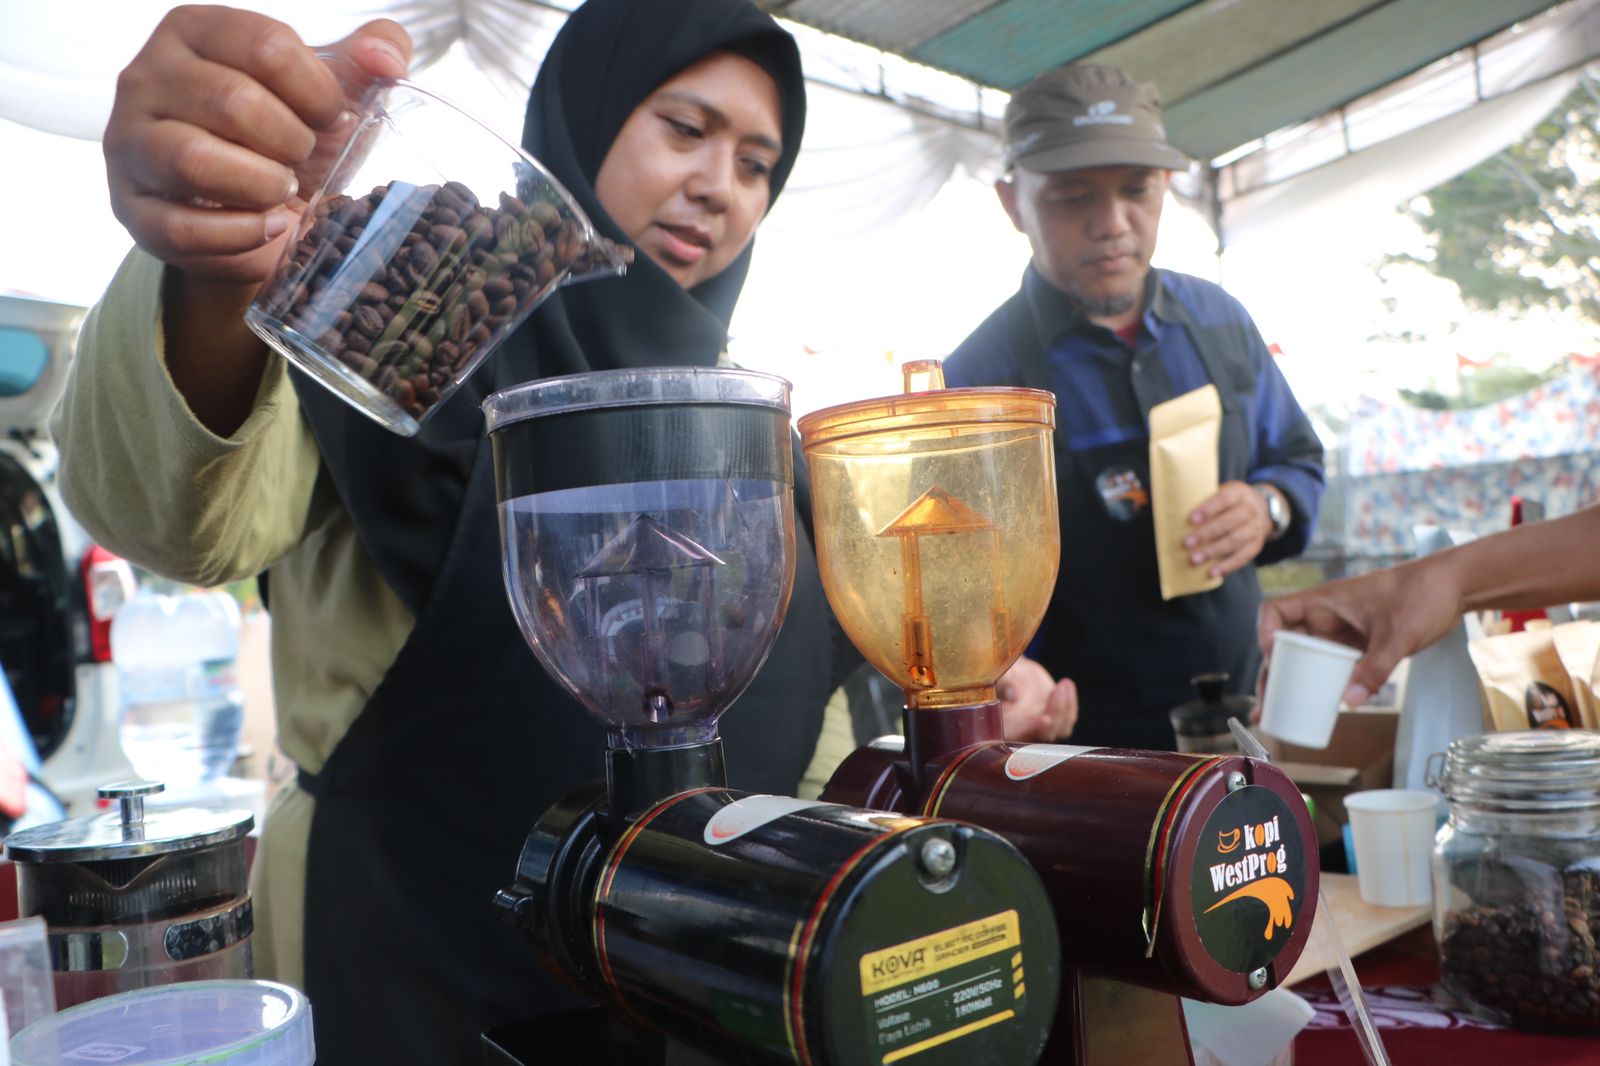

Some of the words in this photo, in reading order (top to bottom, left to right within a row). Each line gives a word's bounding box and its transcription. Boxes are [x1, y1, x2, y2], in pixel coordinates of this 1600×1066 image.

[1243, 815, 1279, 851] kopi
[1209, 844, 1287, 892] WestProg
[872, 948, 926, 978] KOVA
